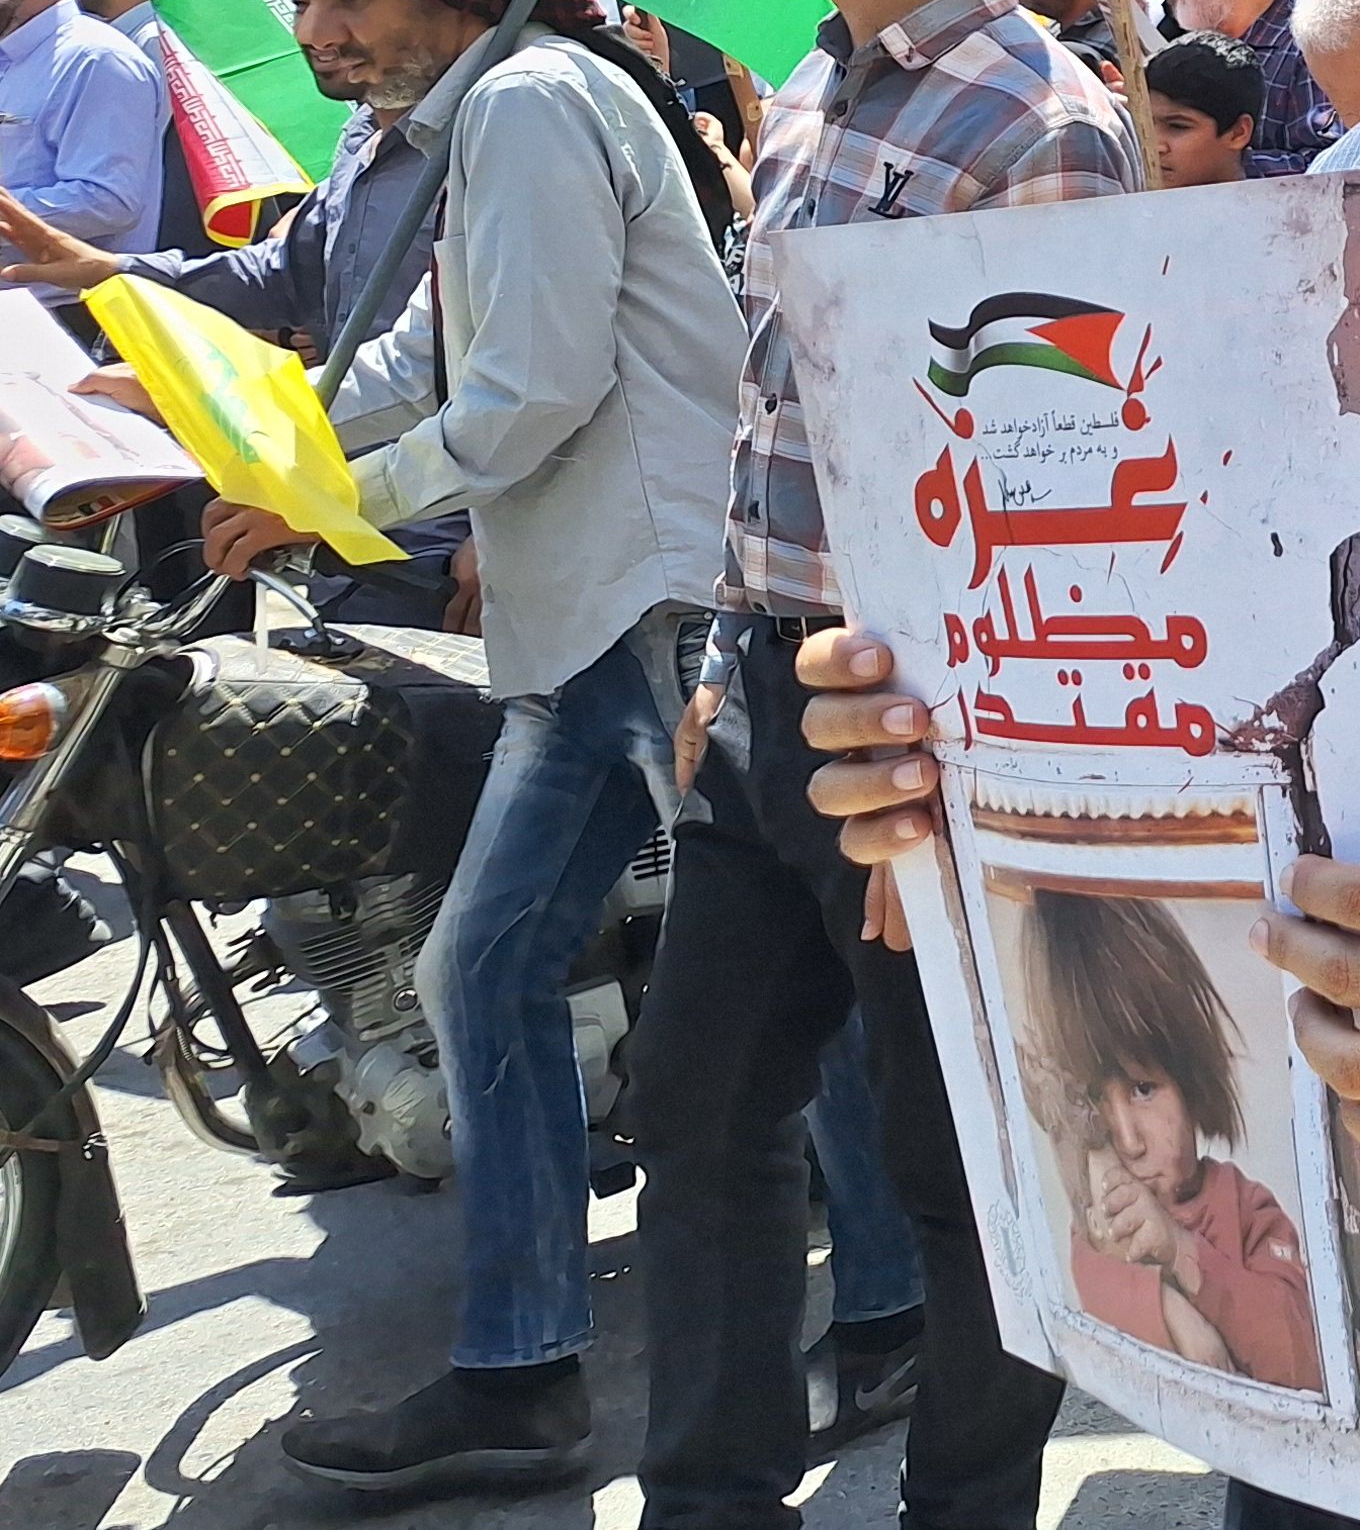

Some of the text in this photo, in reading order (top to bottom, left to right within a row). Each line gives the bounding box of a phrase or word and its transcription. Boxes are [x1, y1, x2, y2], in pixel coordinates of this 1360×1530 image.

[982, 419, 998, 436] شد
[1080, 411, 1120, 436] فلسطین
[1022, 442, 1055, 464] خواهد
[1058, 450, 1068, 465] بر
[1070, 445, 1093, 465] مردم
[1096, 443, 1108, 459] به
[1111, 447, 1119, 460] و
[912, 395, 1189, 590] غزه
[943, 563, 1209, 677] مظلوم
[955, 661, 1218, 758] مقتدر
